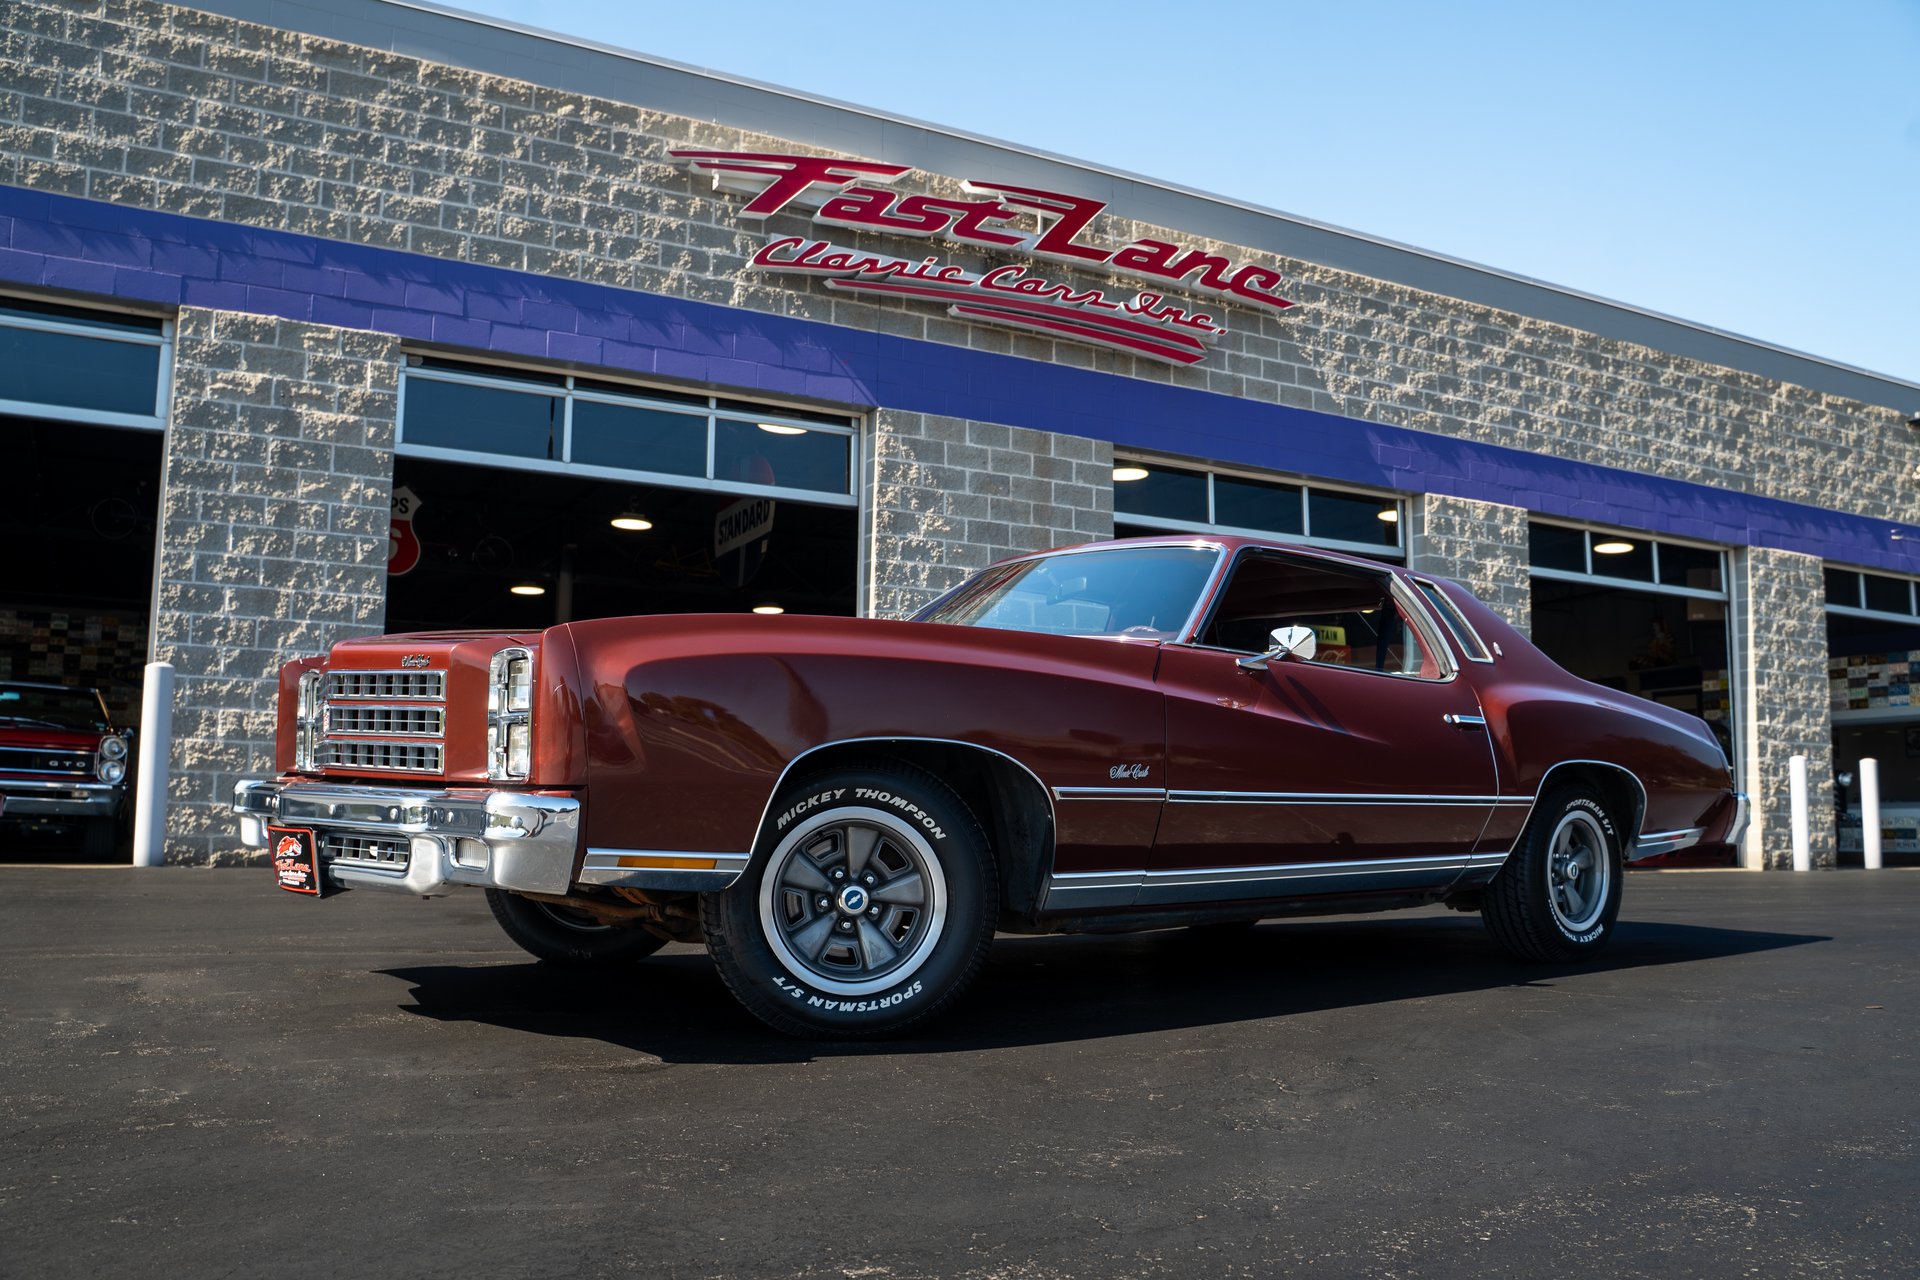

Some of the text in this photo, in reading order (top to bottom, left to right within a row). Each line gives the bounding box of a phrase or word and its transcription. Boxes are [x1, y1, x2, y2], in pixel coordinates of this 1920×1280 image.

[668, 149, 1297, 310] Fast Lane
[749, 236, 1227, 335] Classic Cars Inc.
[718, 500, 770, 545] STANDARD
[48, 759, 86, 768] GTO
[776, 787, 947, 841] MICKEY THOMPSON
[1565, 798, 1614, 836] SPORTSMAN S/T
[1579, 923, 1605, 943] MICKEY
[772, 975, 923, 1012] SPORTSMAN S/T
